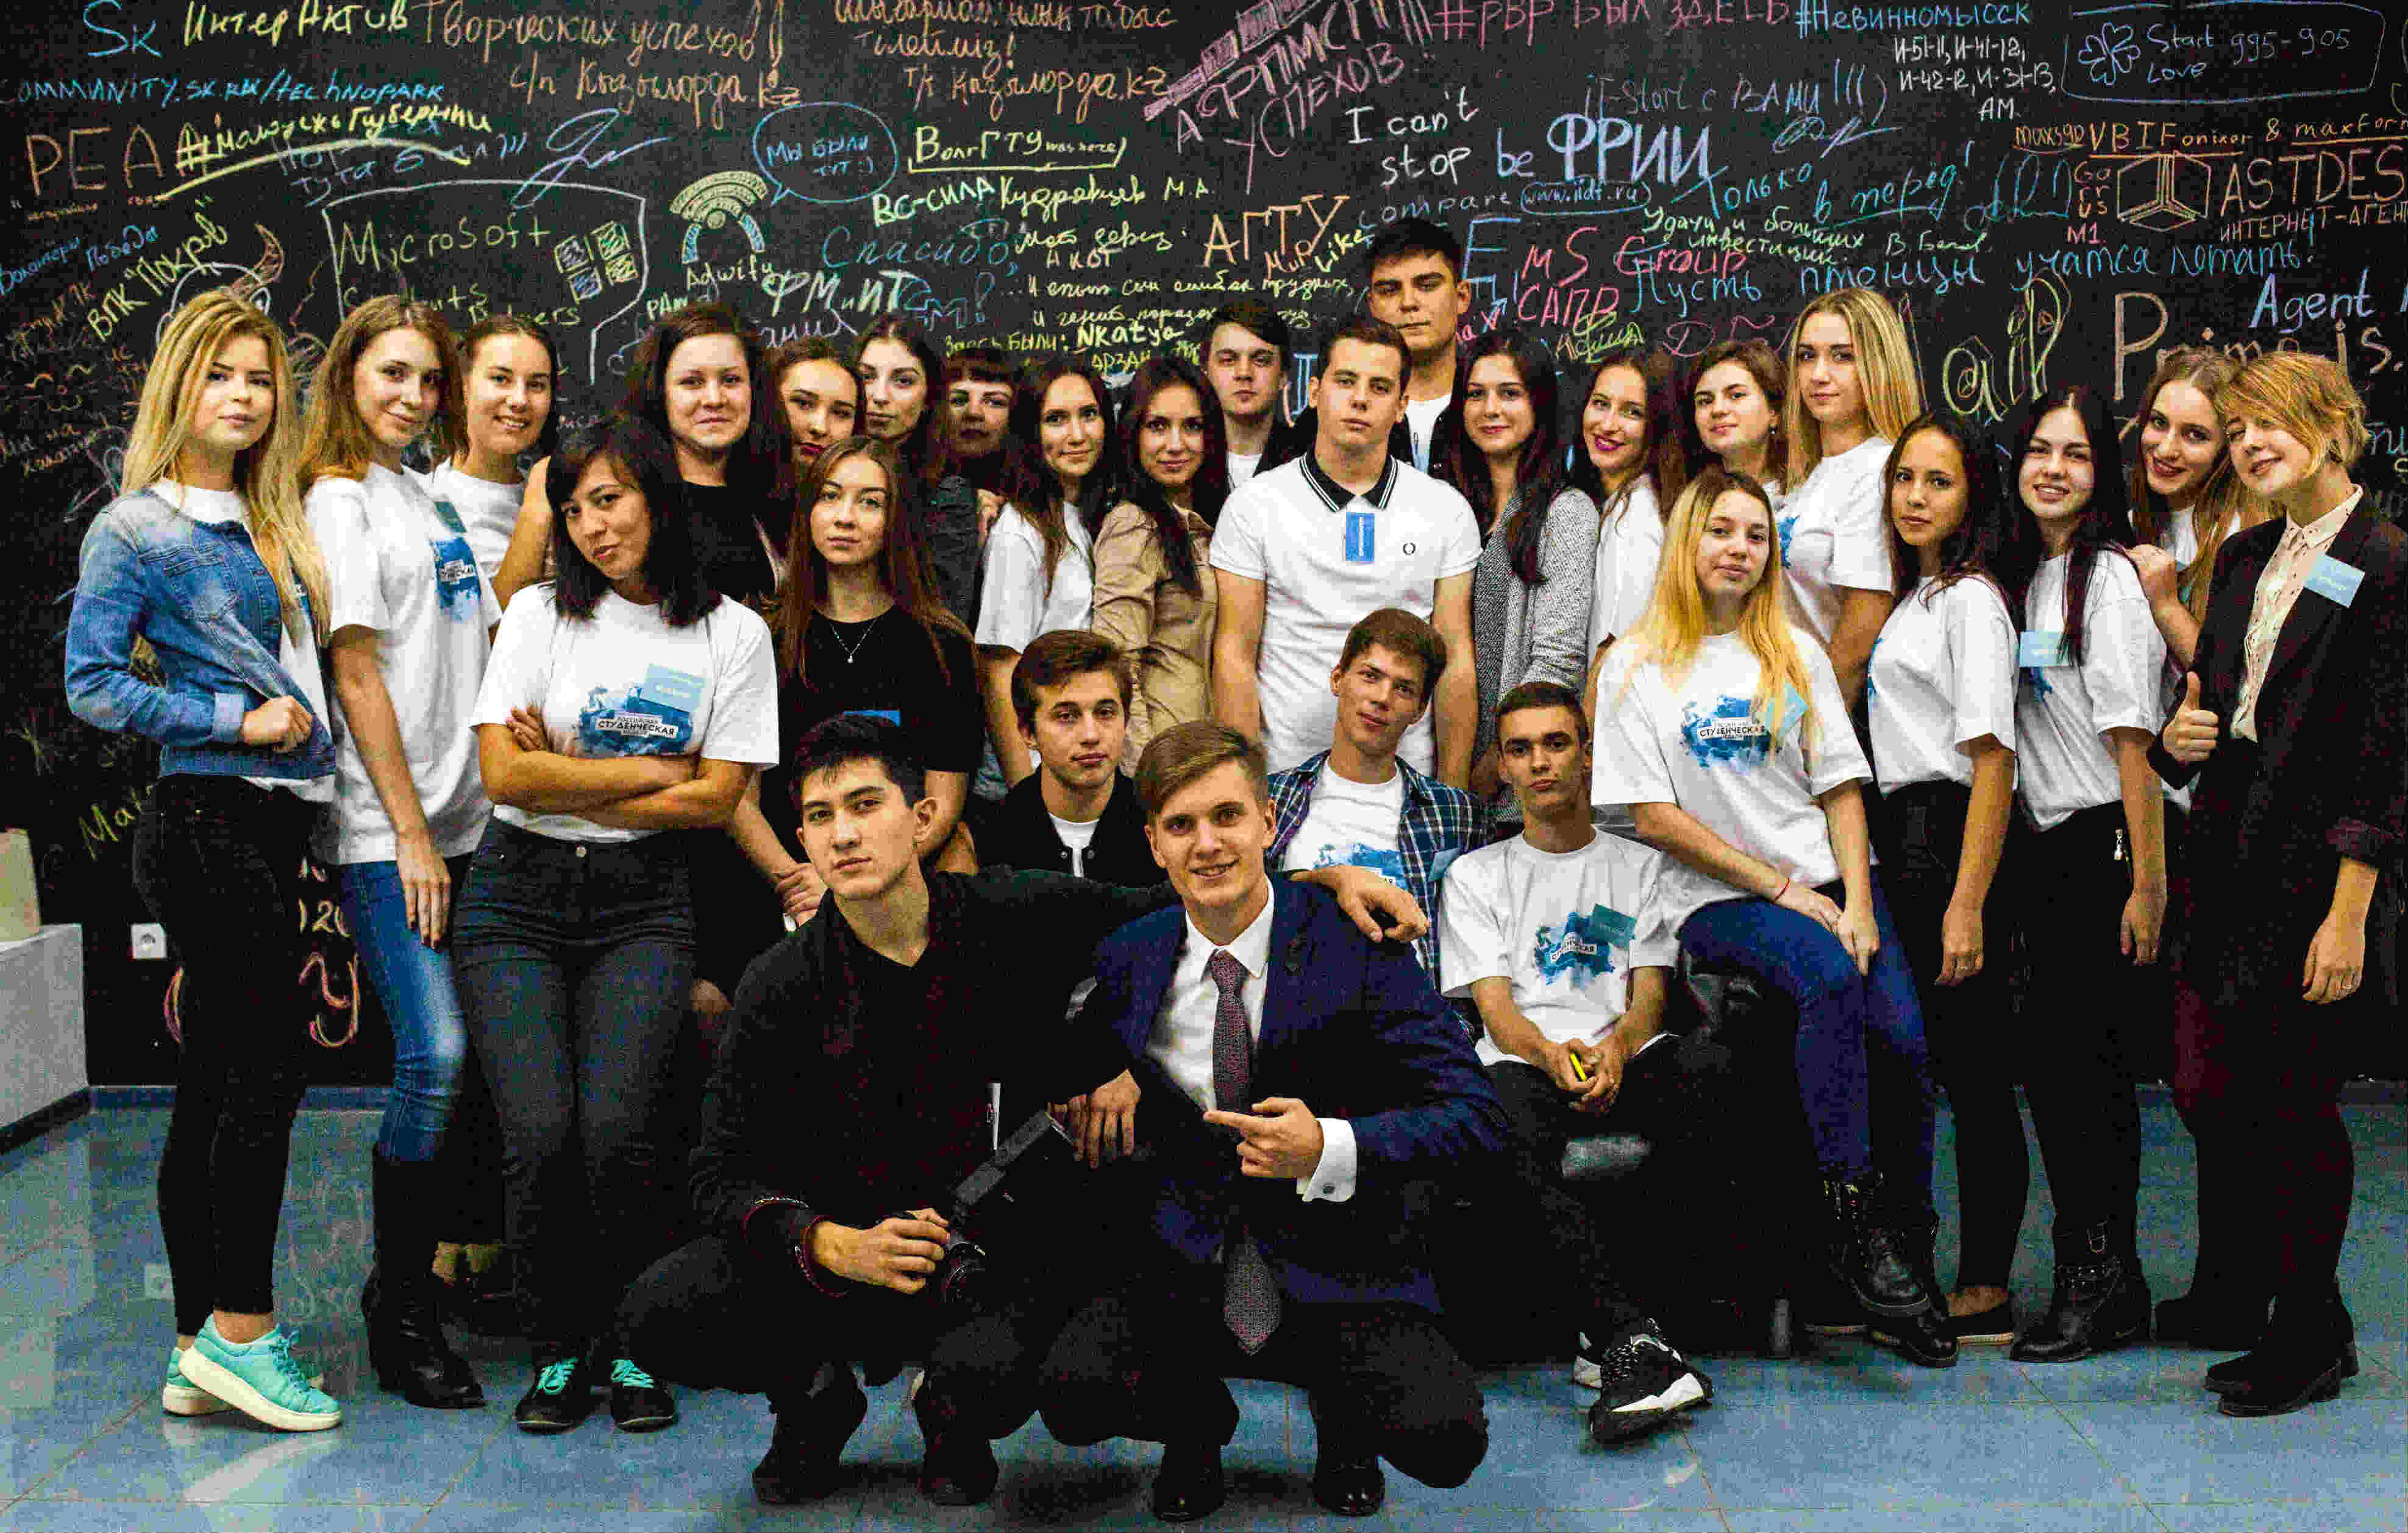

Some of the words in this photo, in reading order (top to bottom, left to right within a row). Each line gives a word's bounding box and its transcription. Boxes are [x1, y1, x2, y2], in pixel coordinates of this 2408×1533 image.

[1345, 106, 1375, 144] I
[1546, 112, 1711, 187] ФРИИ
[1381, 144, 1472, 185] stop
[1496, 127, 1534, 177] be
[2248, 267, 2375, 334] Agent
[597, 720, 675, 735] СТУДЕНЧЕСКАЯ
